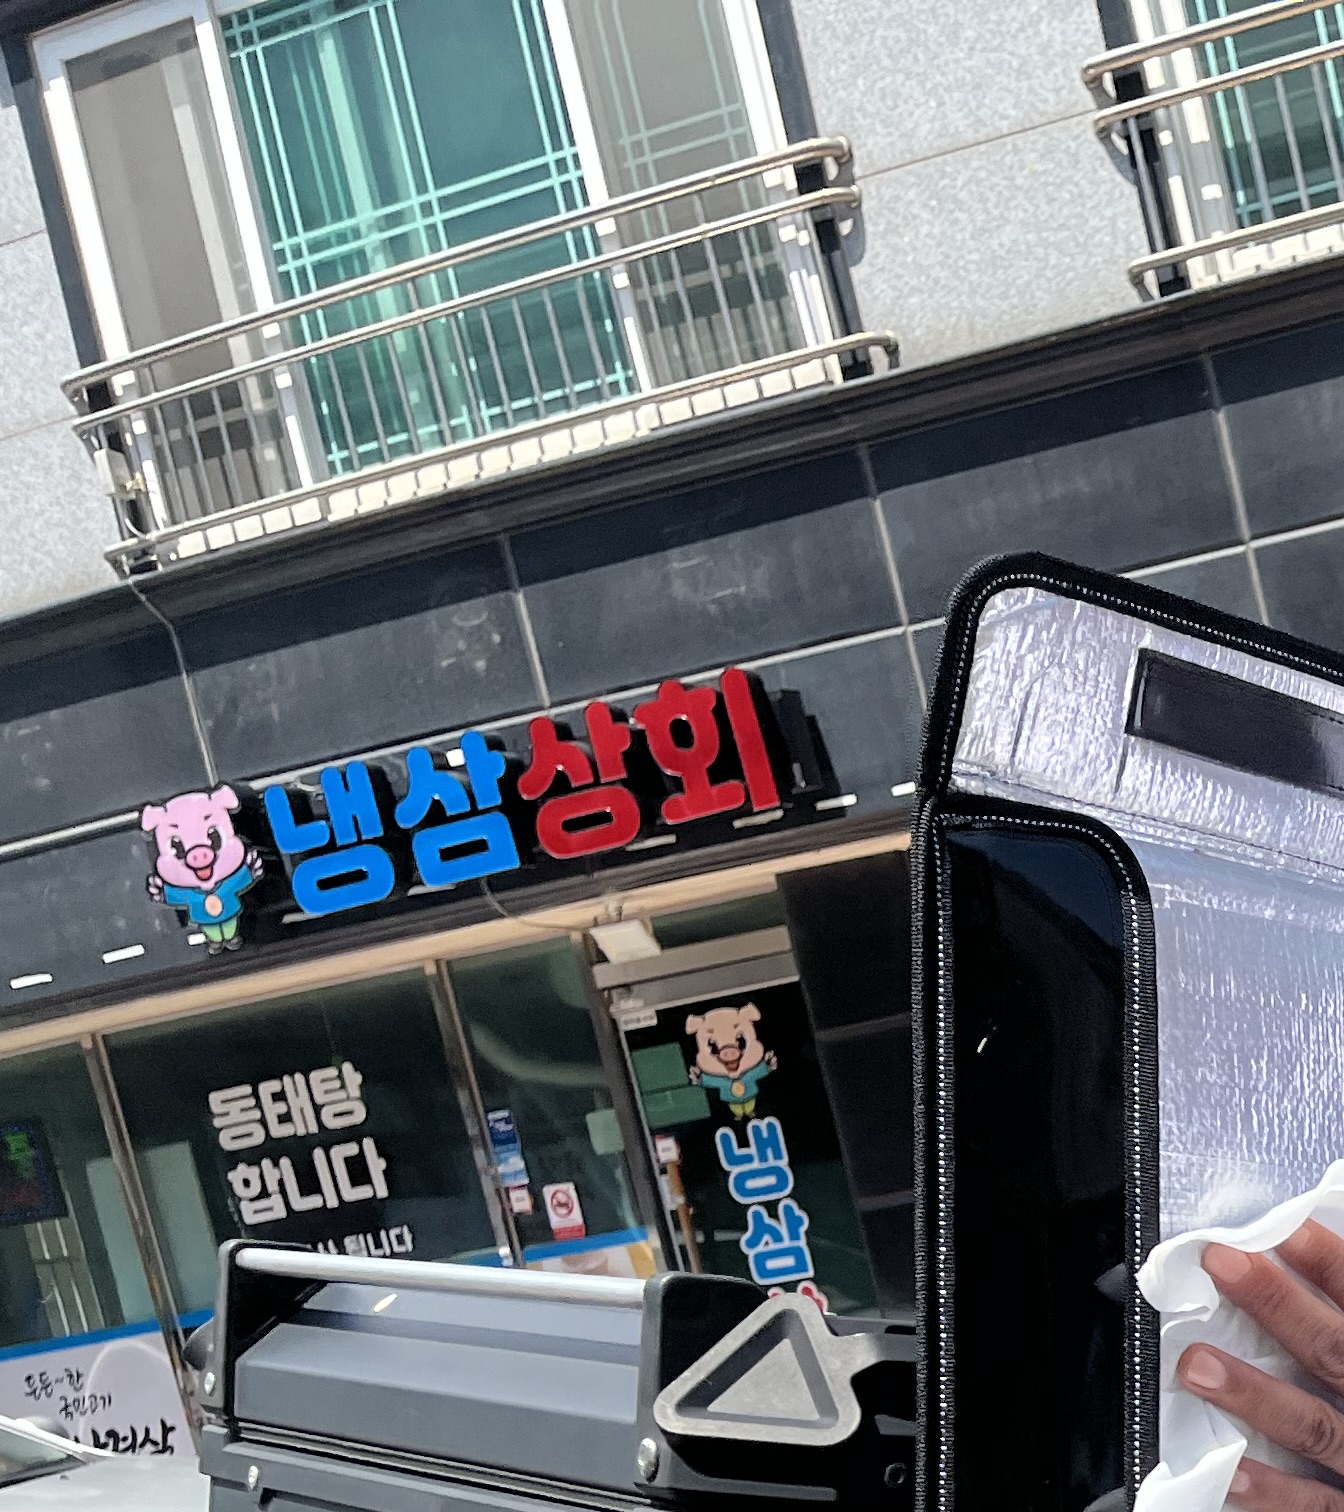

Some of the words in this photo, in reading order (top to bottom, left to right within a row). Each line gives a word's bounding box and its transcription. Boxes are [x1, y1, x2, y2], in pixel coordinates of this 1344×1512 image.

[265, 667, 782, 915] 냉삼상회
[208, 1060, 369, 1152] 동태탕
[227, 1136, 391, 1226] 합니다
[716, 1116, 828, 1314] 냉삼
[59, 1392, 113, 1421] 국민고기
